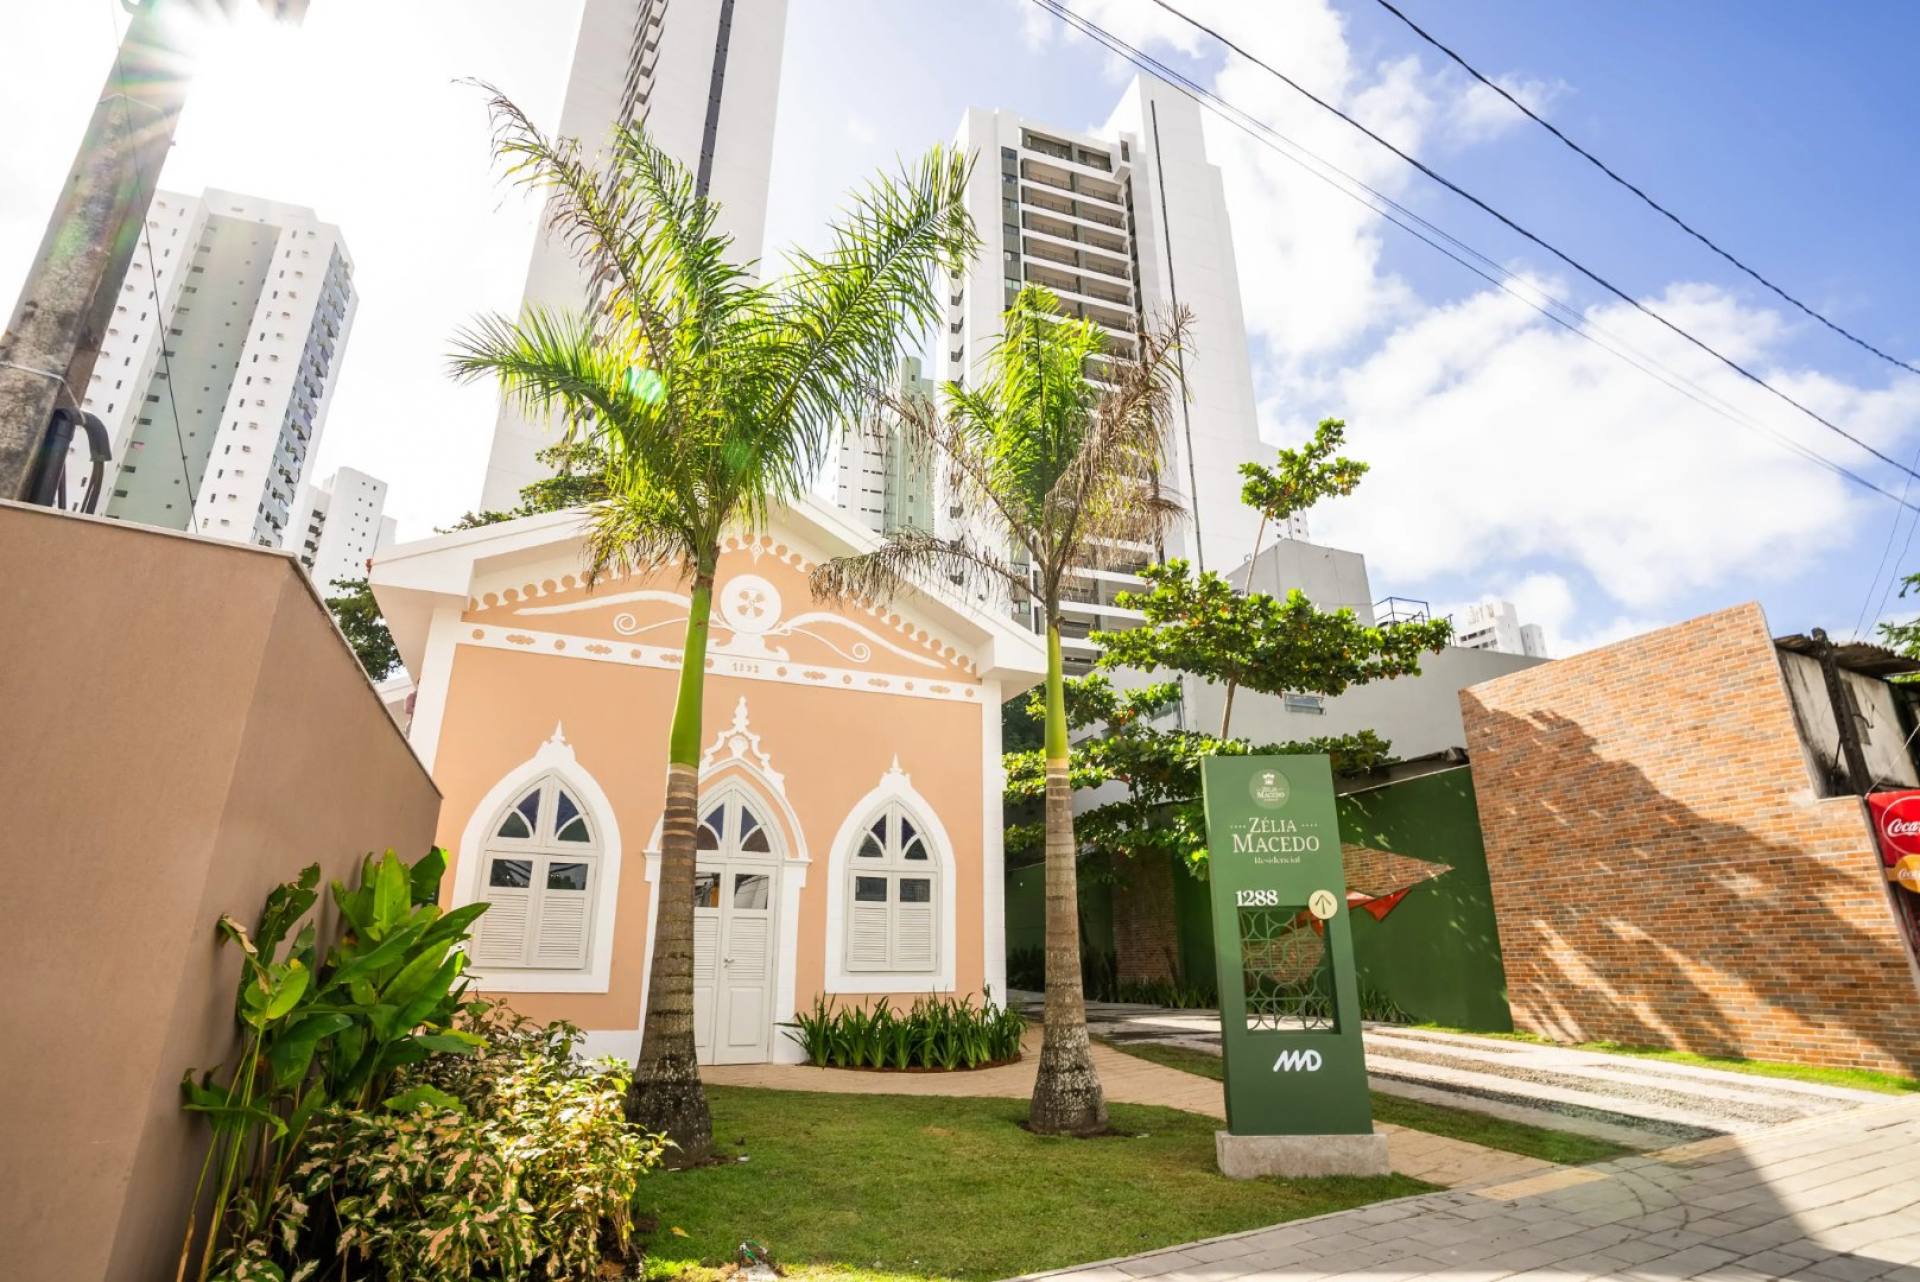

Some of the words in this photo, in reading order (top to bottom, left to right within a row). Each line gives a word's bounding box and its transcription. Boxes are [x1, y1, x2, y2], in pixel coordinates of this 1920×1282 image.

[1249, 817, 1297, 833] ZÉLIA
[1232, 834, 1320, 853] MACEDO
[1236, 889, 1279, 906] 1288
